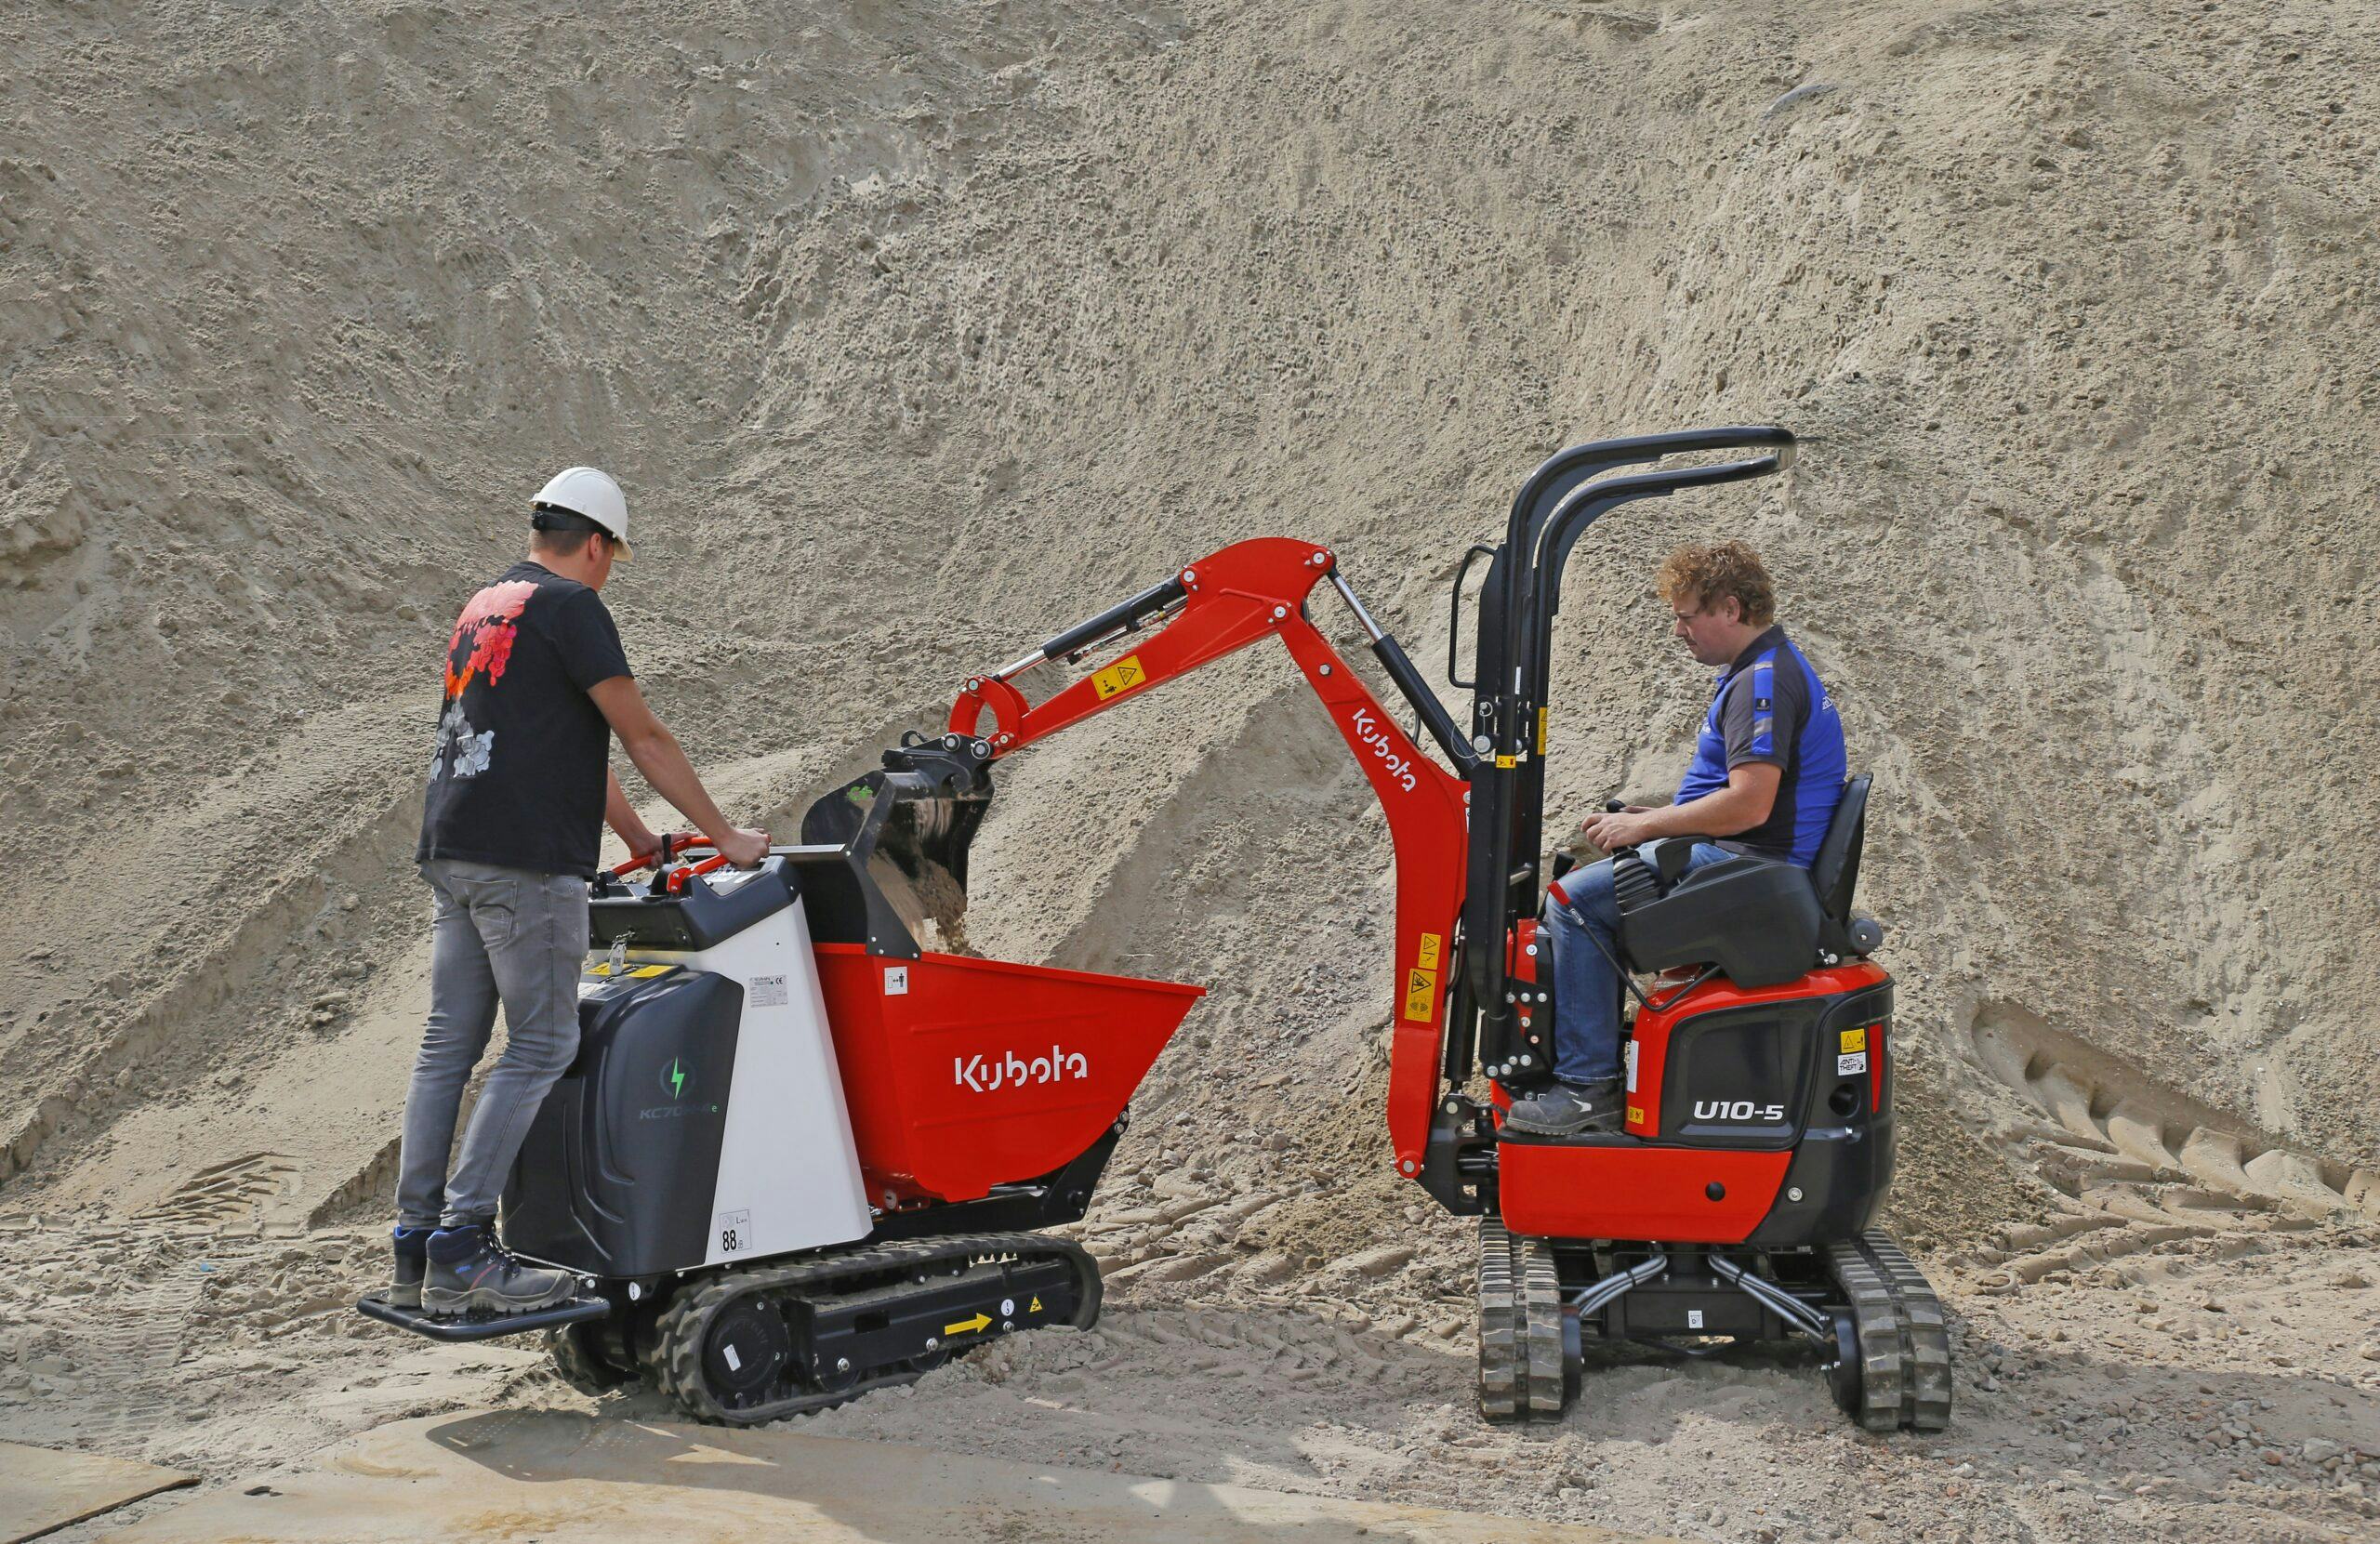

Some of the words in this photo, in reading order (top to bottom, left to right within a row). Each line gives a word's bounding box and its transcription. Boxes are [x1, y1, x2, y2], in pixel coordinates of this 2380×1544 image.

[1352, 707, 1417, 793] Kubota
[954, 1045, 1088, 1092] Kubota
[1694, 1101, 1785, 1120] U10-5
[722, 1229, 737, 1252] 88
